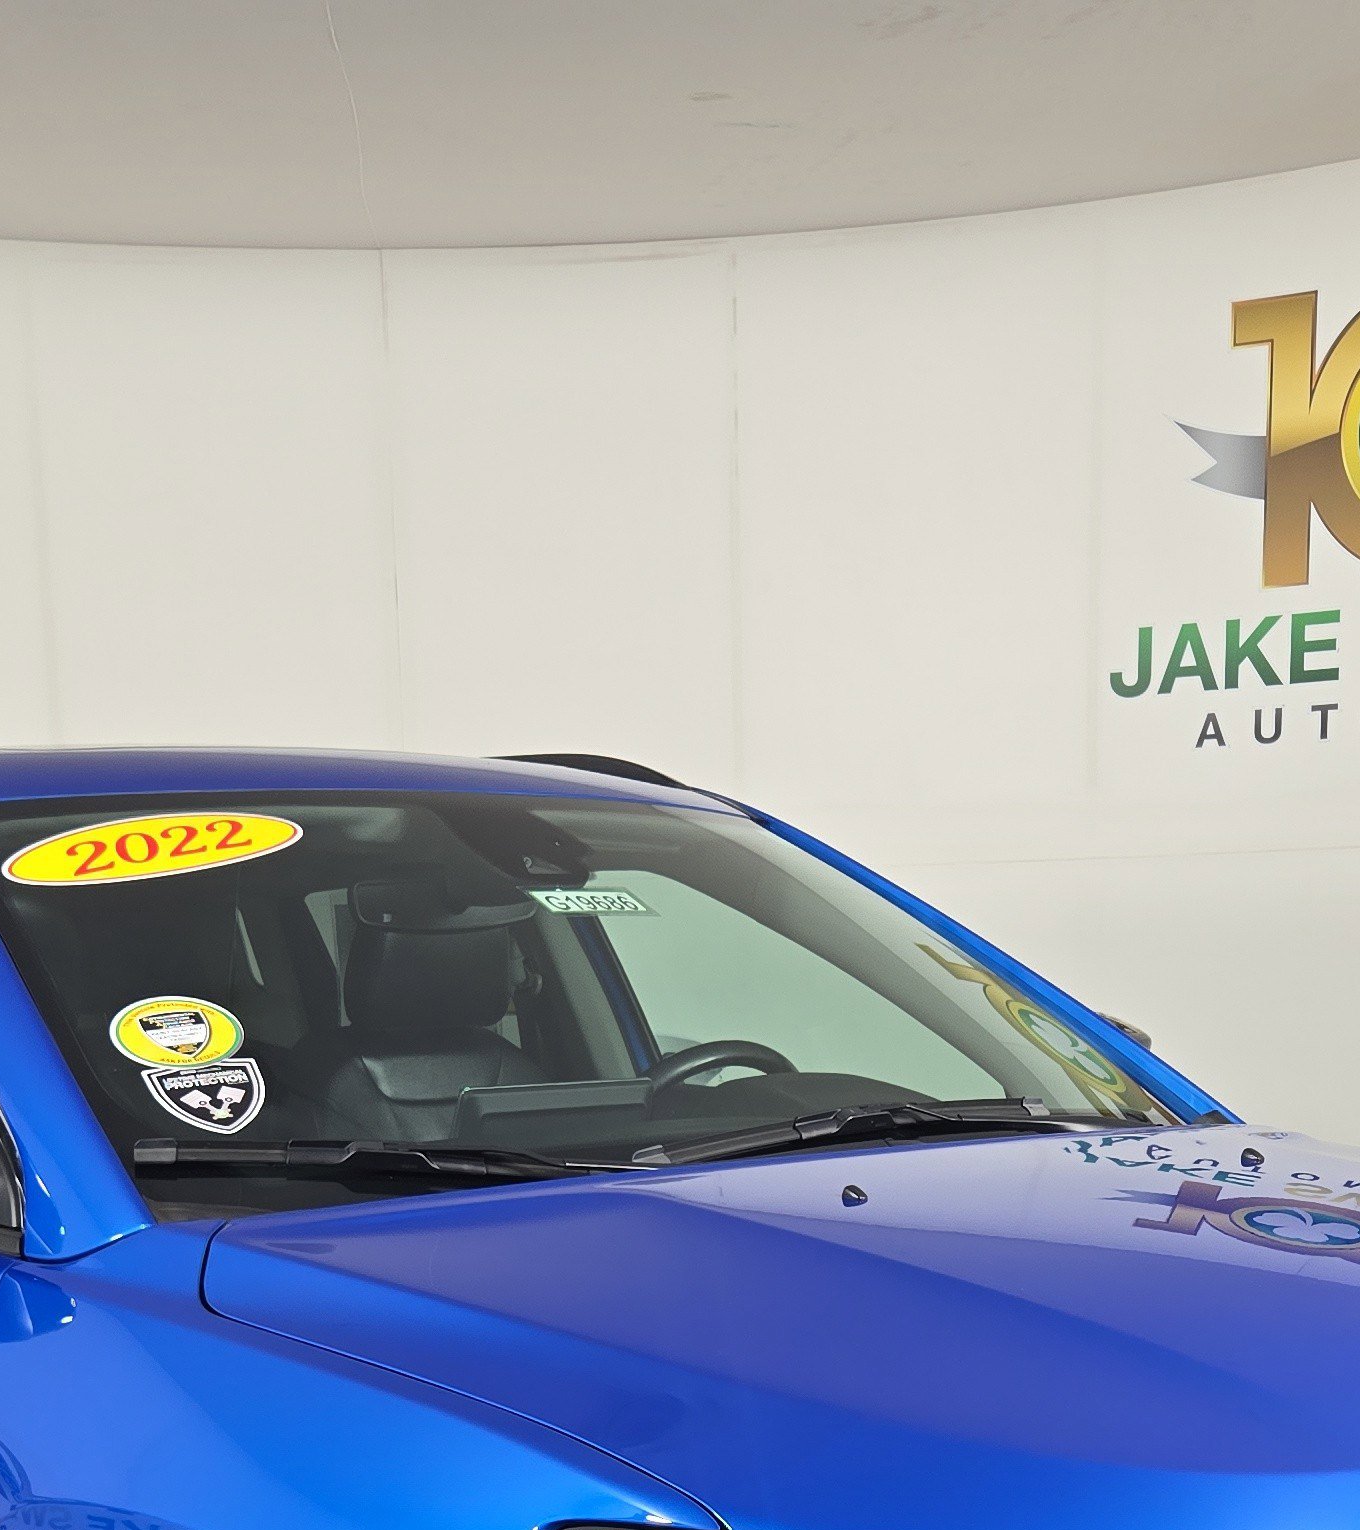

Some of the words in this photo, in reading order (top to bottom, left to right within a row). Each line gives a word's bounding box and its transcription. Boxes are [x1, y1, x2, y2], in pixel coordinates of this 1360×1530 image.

[1109, 609, 1341, 698] JAKE
[66, 819, 252, 876] 2022
[545, 895, 639, 911] G19686
[164, 1072, 249, 1090] PROTECTION
